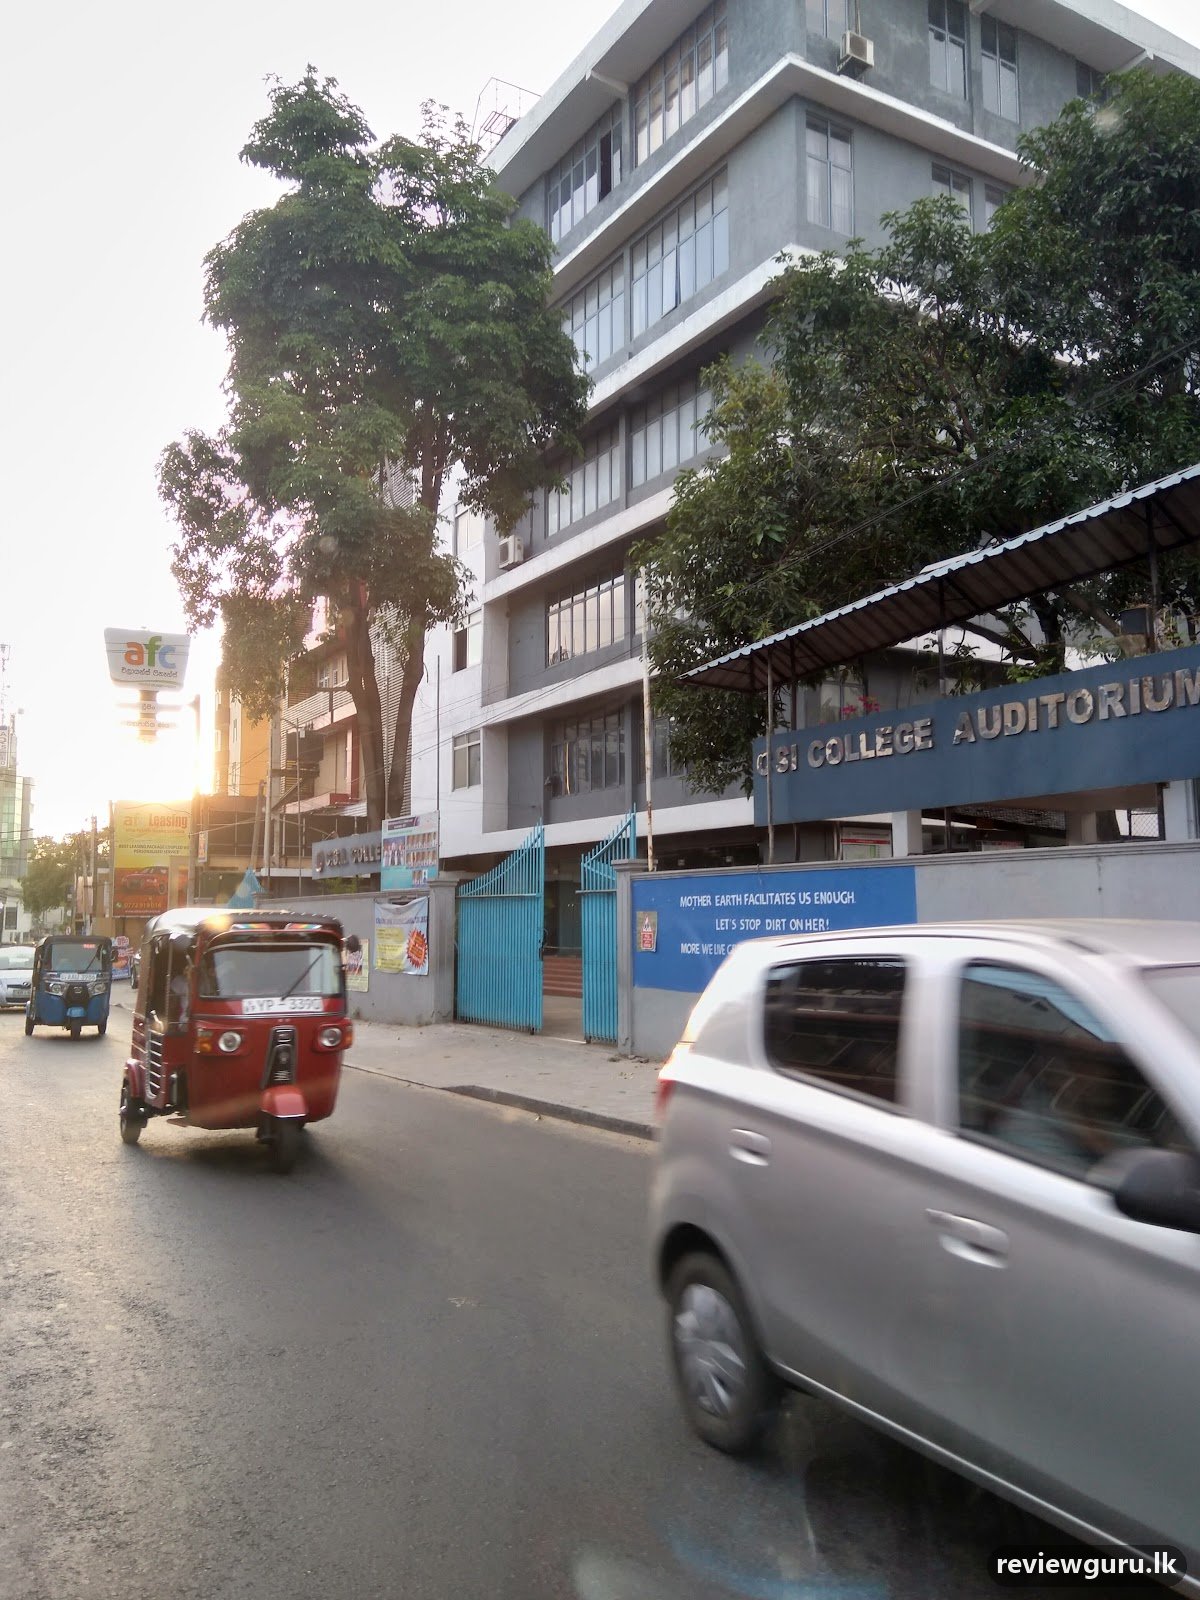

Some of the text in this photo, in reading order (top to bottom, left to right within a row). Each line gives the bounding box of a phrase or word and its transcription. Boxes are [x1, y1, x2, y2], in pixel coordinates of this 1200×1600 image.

[124, 635, 176, 669] afc
[807, 717, 933, 768] COLLEGE
[952, 666, 1200, 746] AUDITORIUM
[148, 813, 188, 829] Leasing
[680, 895, 712, 908] MOTHER
[715, 893, 742, 907] EARTH
[743, 892, 796, 906] FACILITATES
[798, 891, 812, 905] US
[715, 918, 830, 931] LET'S STOP DIRT ON HER!
[680, 942, 700, 955] MORE
[701, 943, 713, 955] WE
